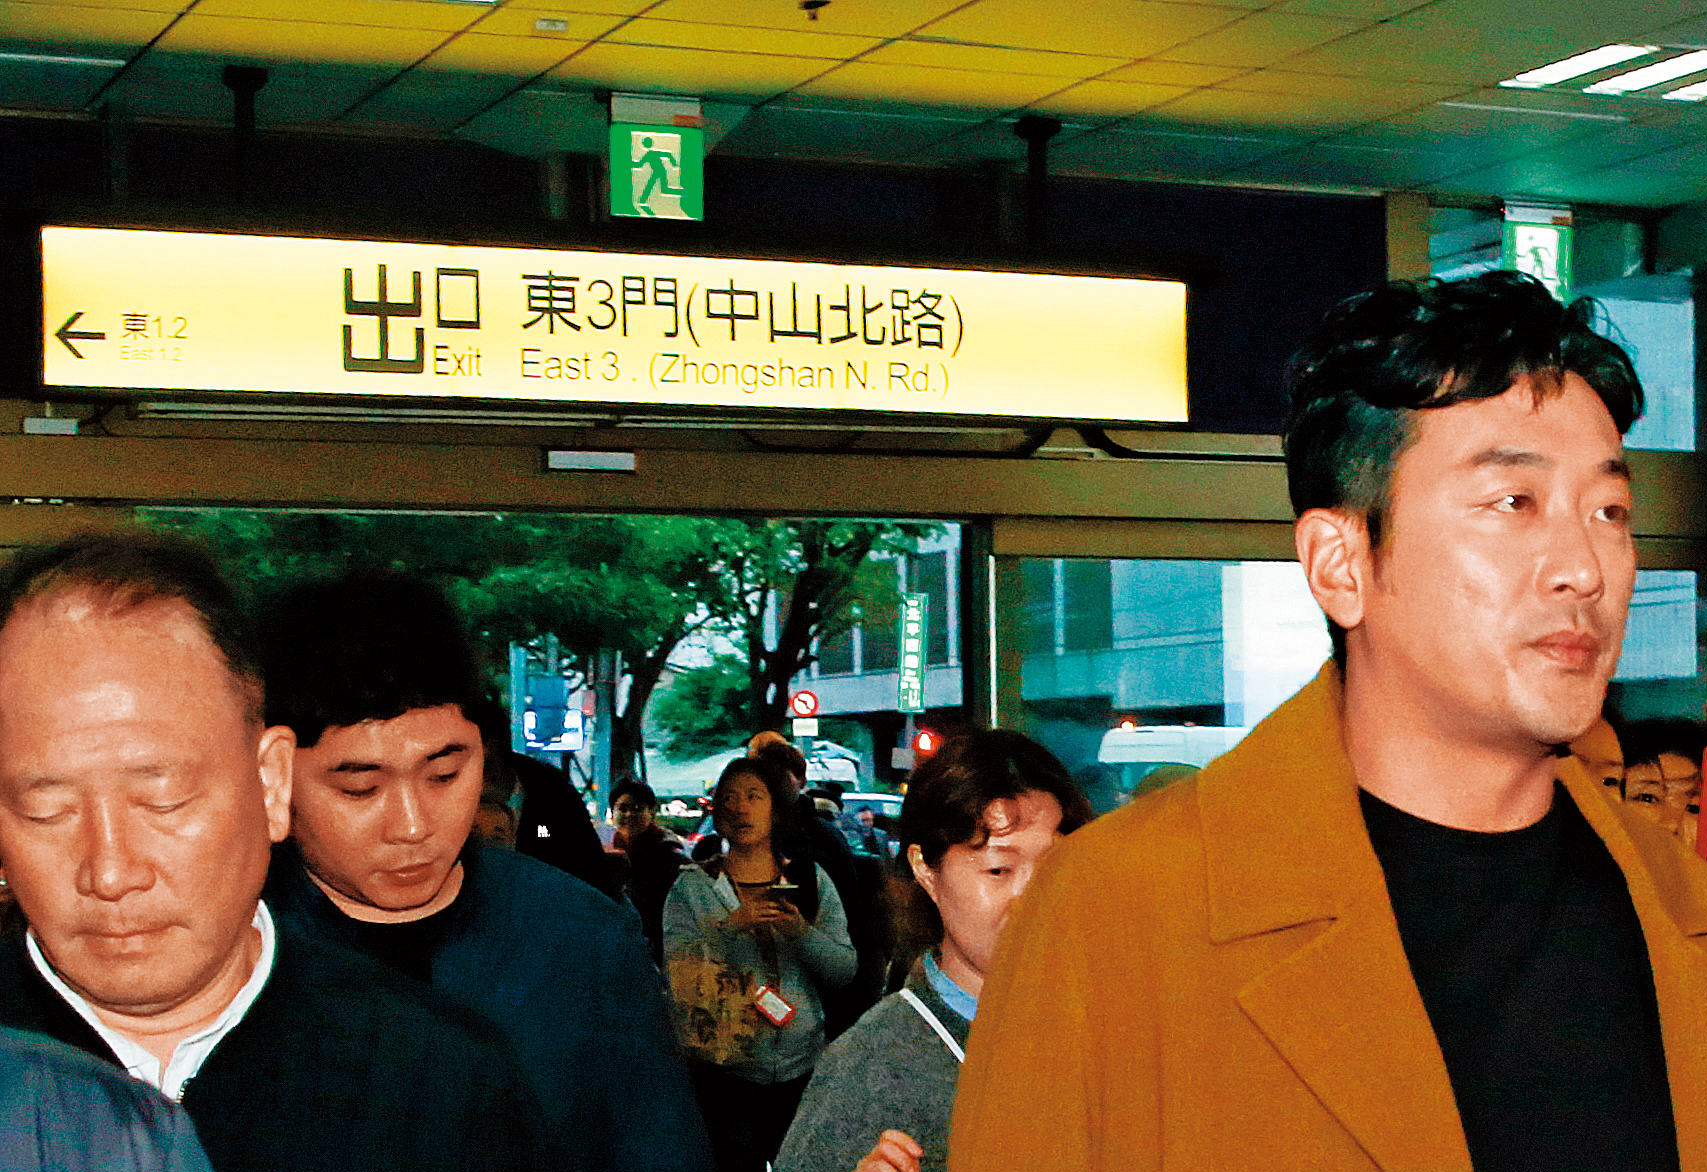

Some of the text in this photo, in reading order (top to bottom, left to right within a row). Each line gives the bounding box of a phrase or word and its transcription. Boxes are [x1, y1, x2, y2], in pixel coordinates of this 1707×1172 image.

[342, 263, 964, 374] 出口 東3門(中山北路)
[120, 345, 154, 362] East
[433, 344, 483, 377] Exit
[520, 347, 593, 380] East
[649, 351, 834, 394] (Zhongshan
[845, 359, 877, 391] N.
[887, 361, 950, 401] Rd.)
